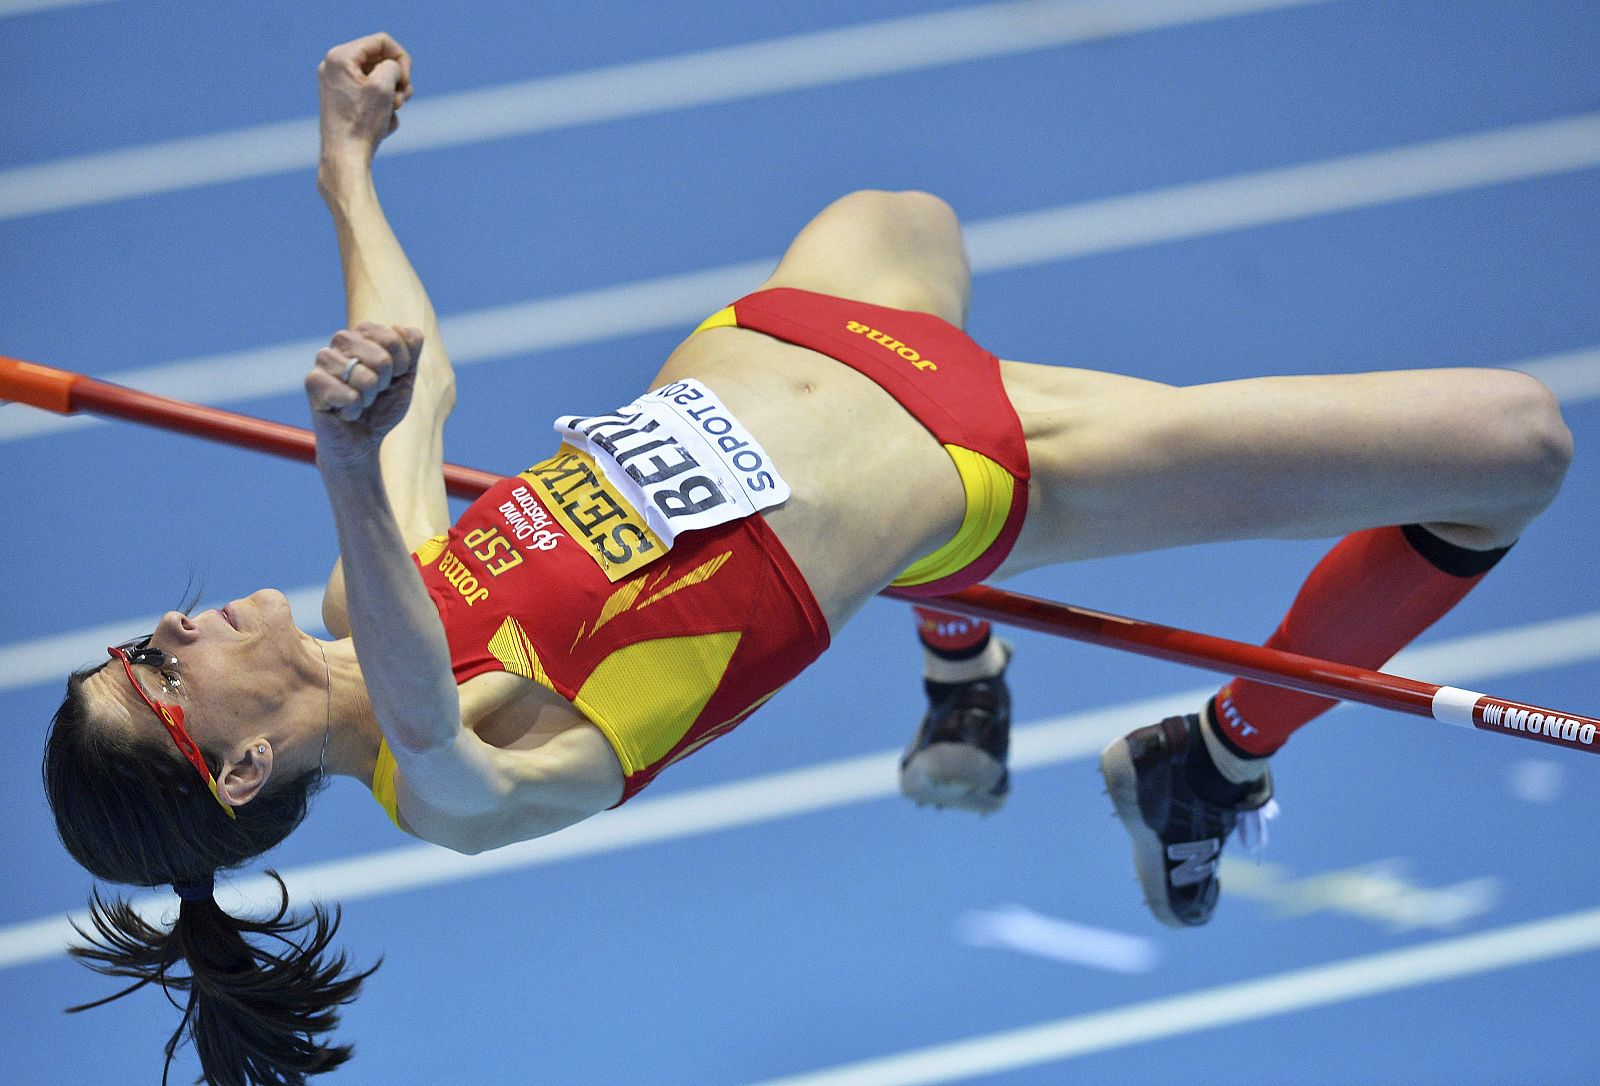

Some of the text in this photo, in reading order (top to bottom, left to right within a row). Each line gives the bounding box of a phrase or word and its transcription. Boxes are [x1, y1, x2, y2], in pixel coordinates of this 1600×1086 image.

[846, 320, 938, 372] Joma
[567, 413, 727, 520] BEITI
[686, 405, 775, 492] SOPOT
[498, 500, 535, 541] Divina
[511, 485, 553, 531] Pastora
[530, 453, 655, 565] SEIK
[438, 549, 490, 607] Joma
[463, 527, 524, 577] ESP
[1504, 706, 1597, 745] MONDO
